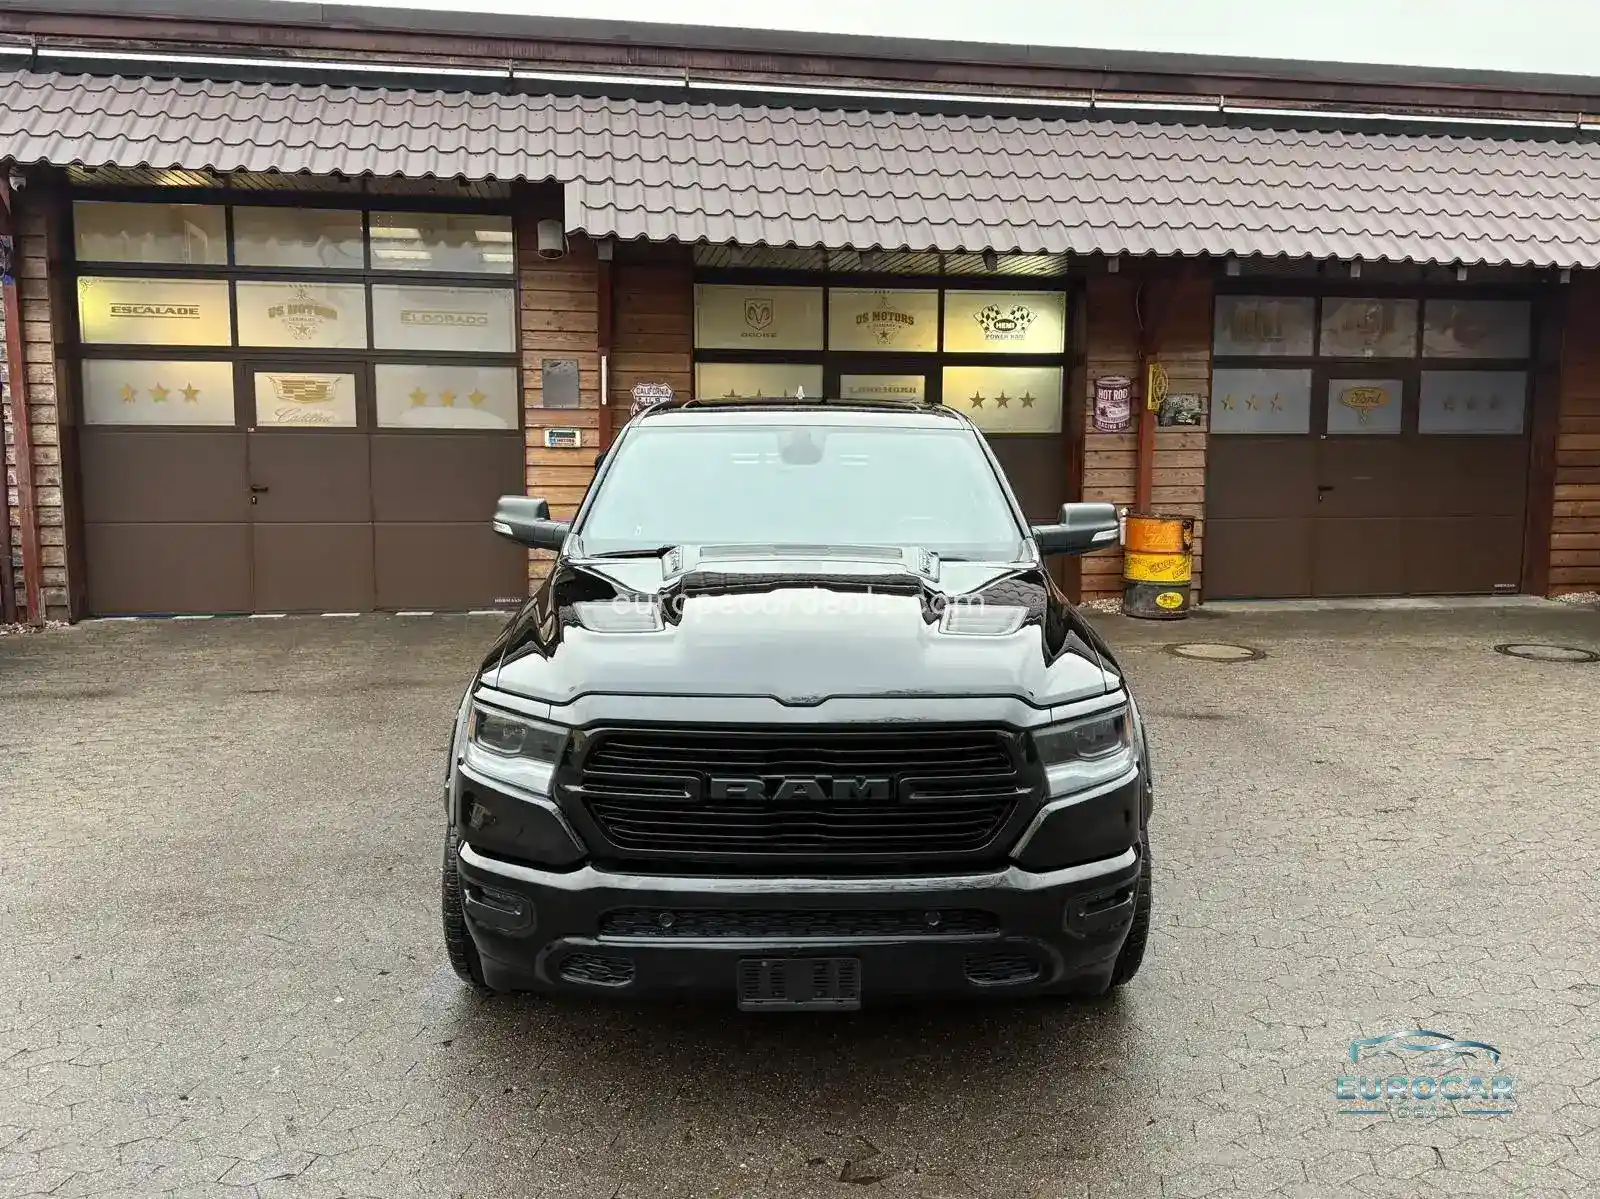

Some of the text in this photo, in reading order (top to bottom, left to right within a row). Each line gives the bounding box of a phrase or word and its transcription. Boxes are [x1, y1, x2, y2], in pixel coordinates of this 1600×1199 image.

[111, 305, 200, 316] ESCALADE
[400, 312, 488, 324] ELDORADO
[872, 311, 915, 326] MOTORS
[636, 386, 670, 396] CALIFORNIA
[1098, 388, 1128, 401] HOT ROD
[710, 778, 890, 801] RAM
